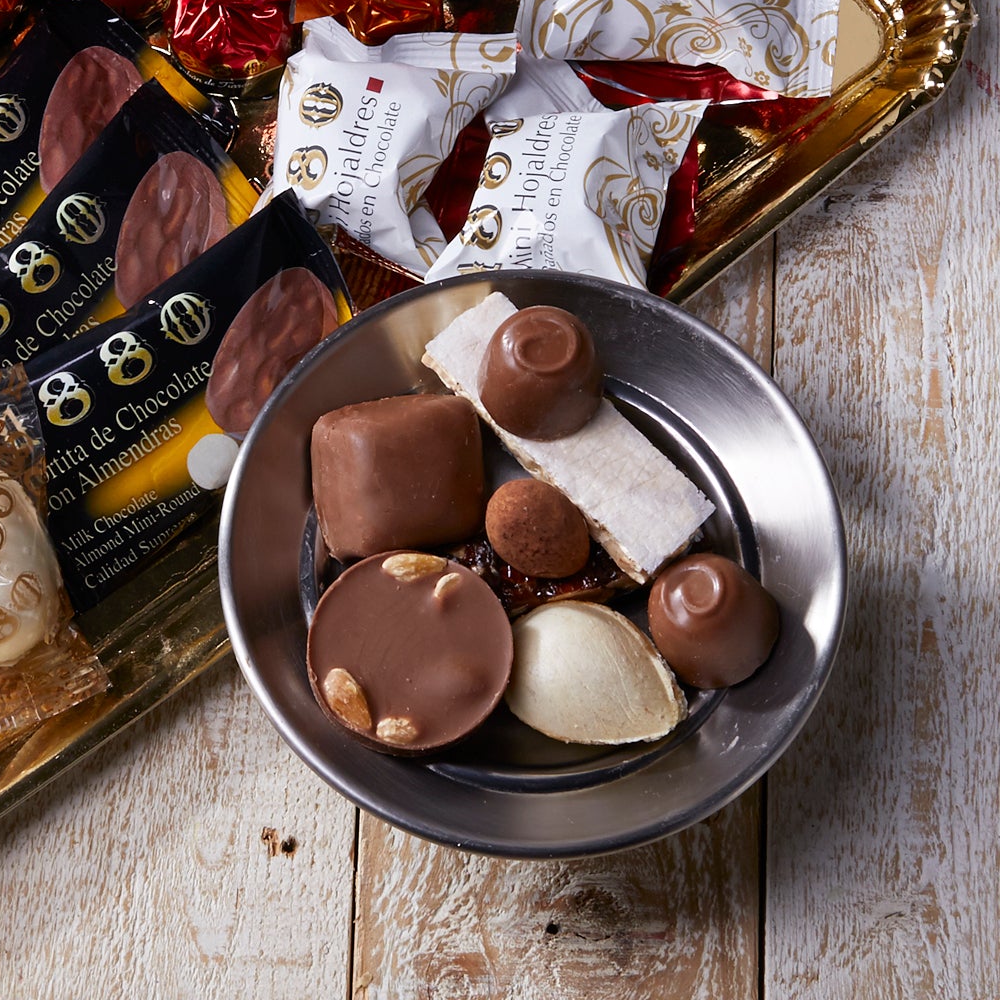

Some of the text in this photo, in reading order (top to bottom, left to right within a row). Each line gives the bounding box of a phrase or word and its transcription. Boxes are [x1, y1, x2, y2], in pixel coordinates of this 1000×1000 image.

[329, 95, 378, 211] Hojaldres
[361, 101, 402, 220] en Chocolate
[511, 114, 559, 212] Hojaldres
[550, 115, 583, 183] Chocolate
[548, 187, 563, 207] en
[15, 255, 118, 362] de Chocolate
[90, 424, 116, 452] de
[115, 358, 213, 432] Chocolate
[80, 416, 183, 496] Almendras
[62, 487, 158, 554] Milk Chocolate
[74, 481, 202, 570] Almond Mini-Round
[85, 552, 139, 590] Calidad
